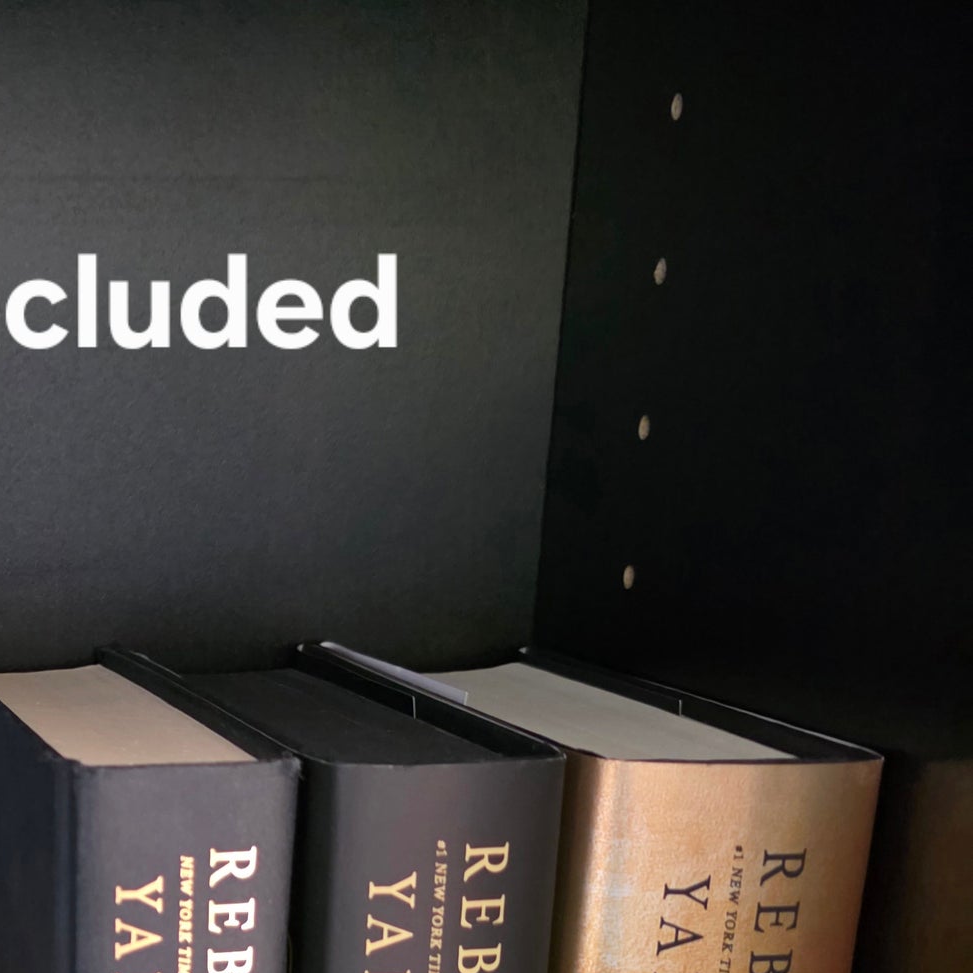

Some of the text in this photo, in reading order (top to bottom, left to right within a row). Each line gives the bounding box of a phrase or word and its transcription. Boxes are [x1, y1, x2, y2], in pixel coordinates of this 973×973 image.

[436, 840, 447, 856] #1
[733, 845, 744, 859] #1
[180, 856, 194, 895] NEW
[433, 863, 447, 902] NEW
[729, 867, 743, 904] NEW
[179, 900, 193, 943] YORK
[430, 905, 444, 949] YORK
[722, 911, 737, 953] YORK
